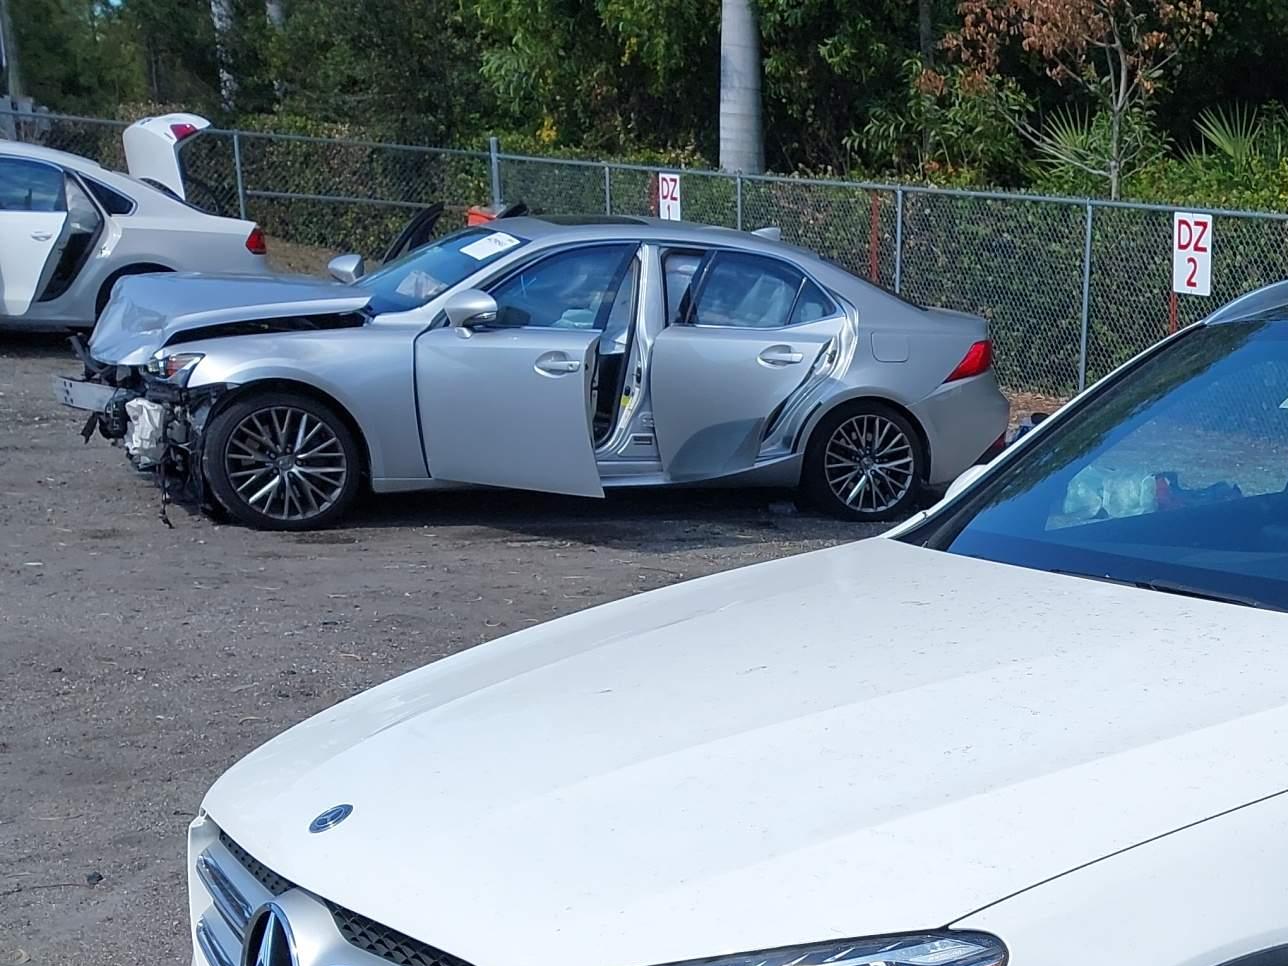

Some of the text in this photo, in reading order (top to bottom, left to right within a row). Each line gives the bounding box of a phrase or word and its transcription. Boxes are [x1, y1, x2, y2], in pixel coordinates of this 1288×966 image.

[661, 176, 678, 201] DZ
[1178, 219, 1208, 252] DZ
[1186, 257, 1198, 288] 2
